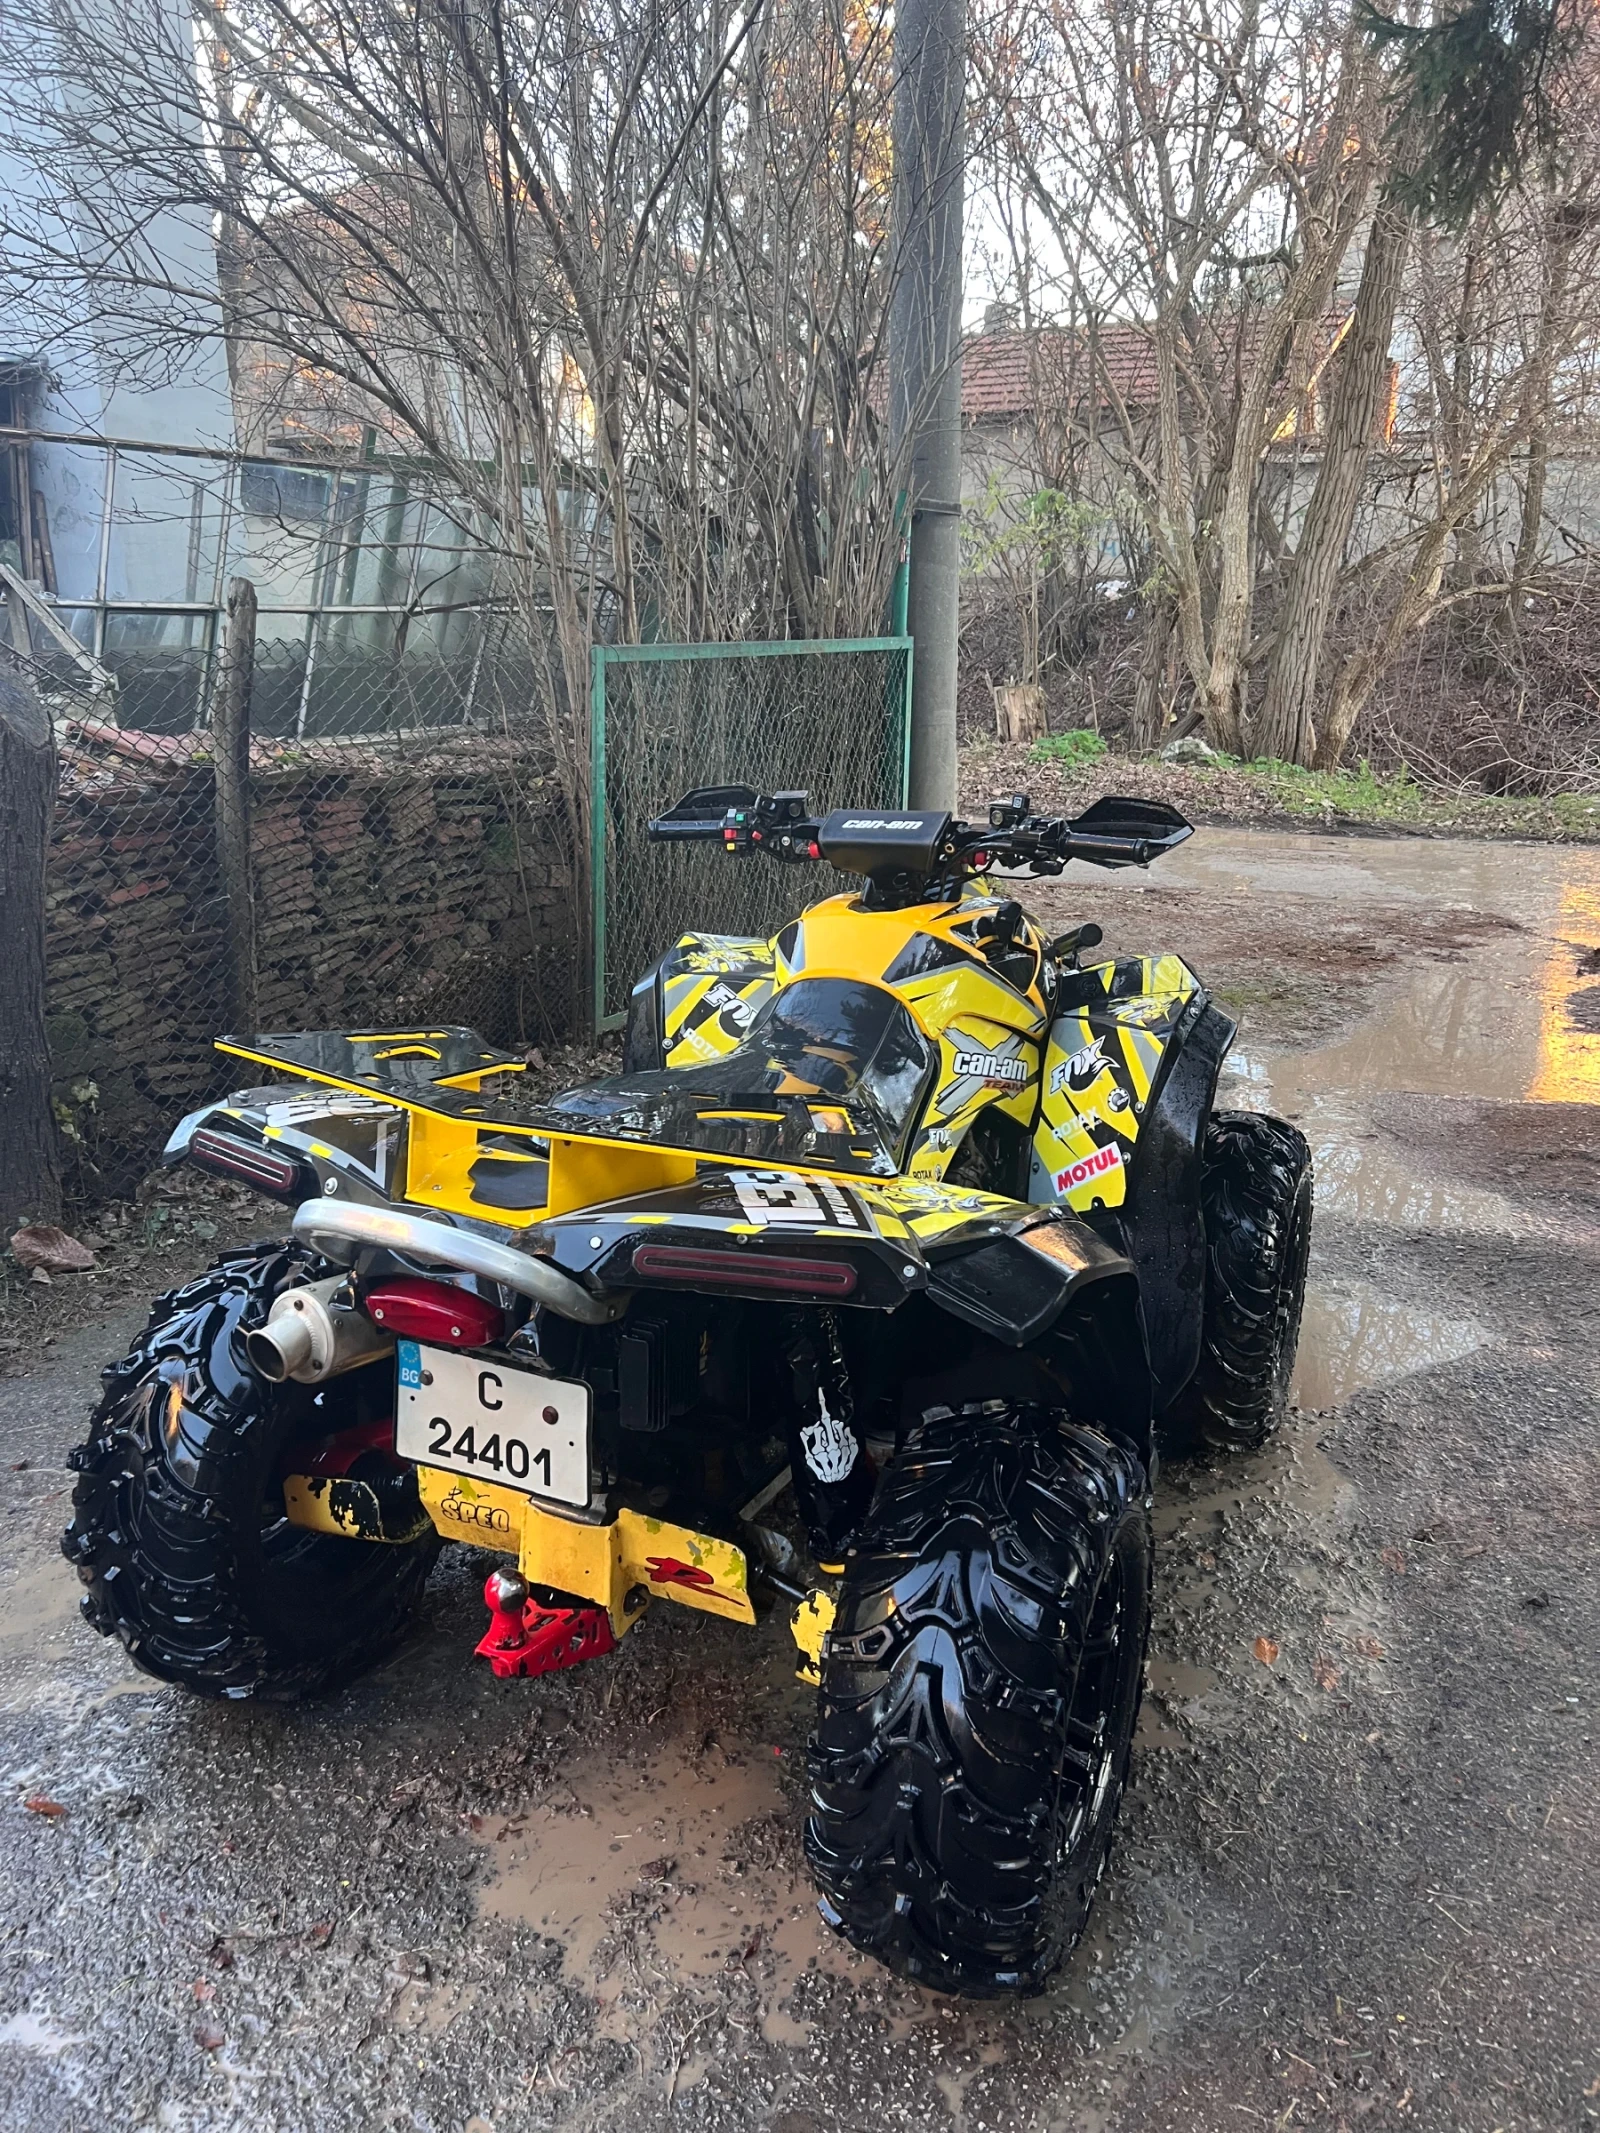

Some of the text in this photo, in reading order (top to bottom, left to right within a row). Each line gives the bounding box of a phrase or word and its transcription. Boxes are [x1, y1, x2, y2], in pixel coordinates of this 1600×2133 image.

[683, 1027, 721, 1059] ROTA
[953, 1052, 1029, 1081] can-am
[1049, 1035, 1112, 1095] FOX
[929, 1128, 953, 1146] FOX
[1052, 1106, 1101, 1142] ROTAX
[912, 1170, 932, 1180] ROTAX
[1056, 1147, 1119, 1192] MOTUL
[401, 1367, 419, 1384] BG
[478, 1371, 503, 1410] C
[428, 1416, 551, 1487] 24401
